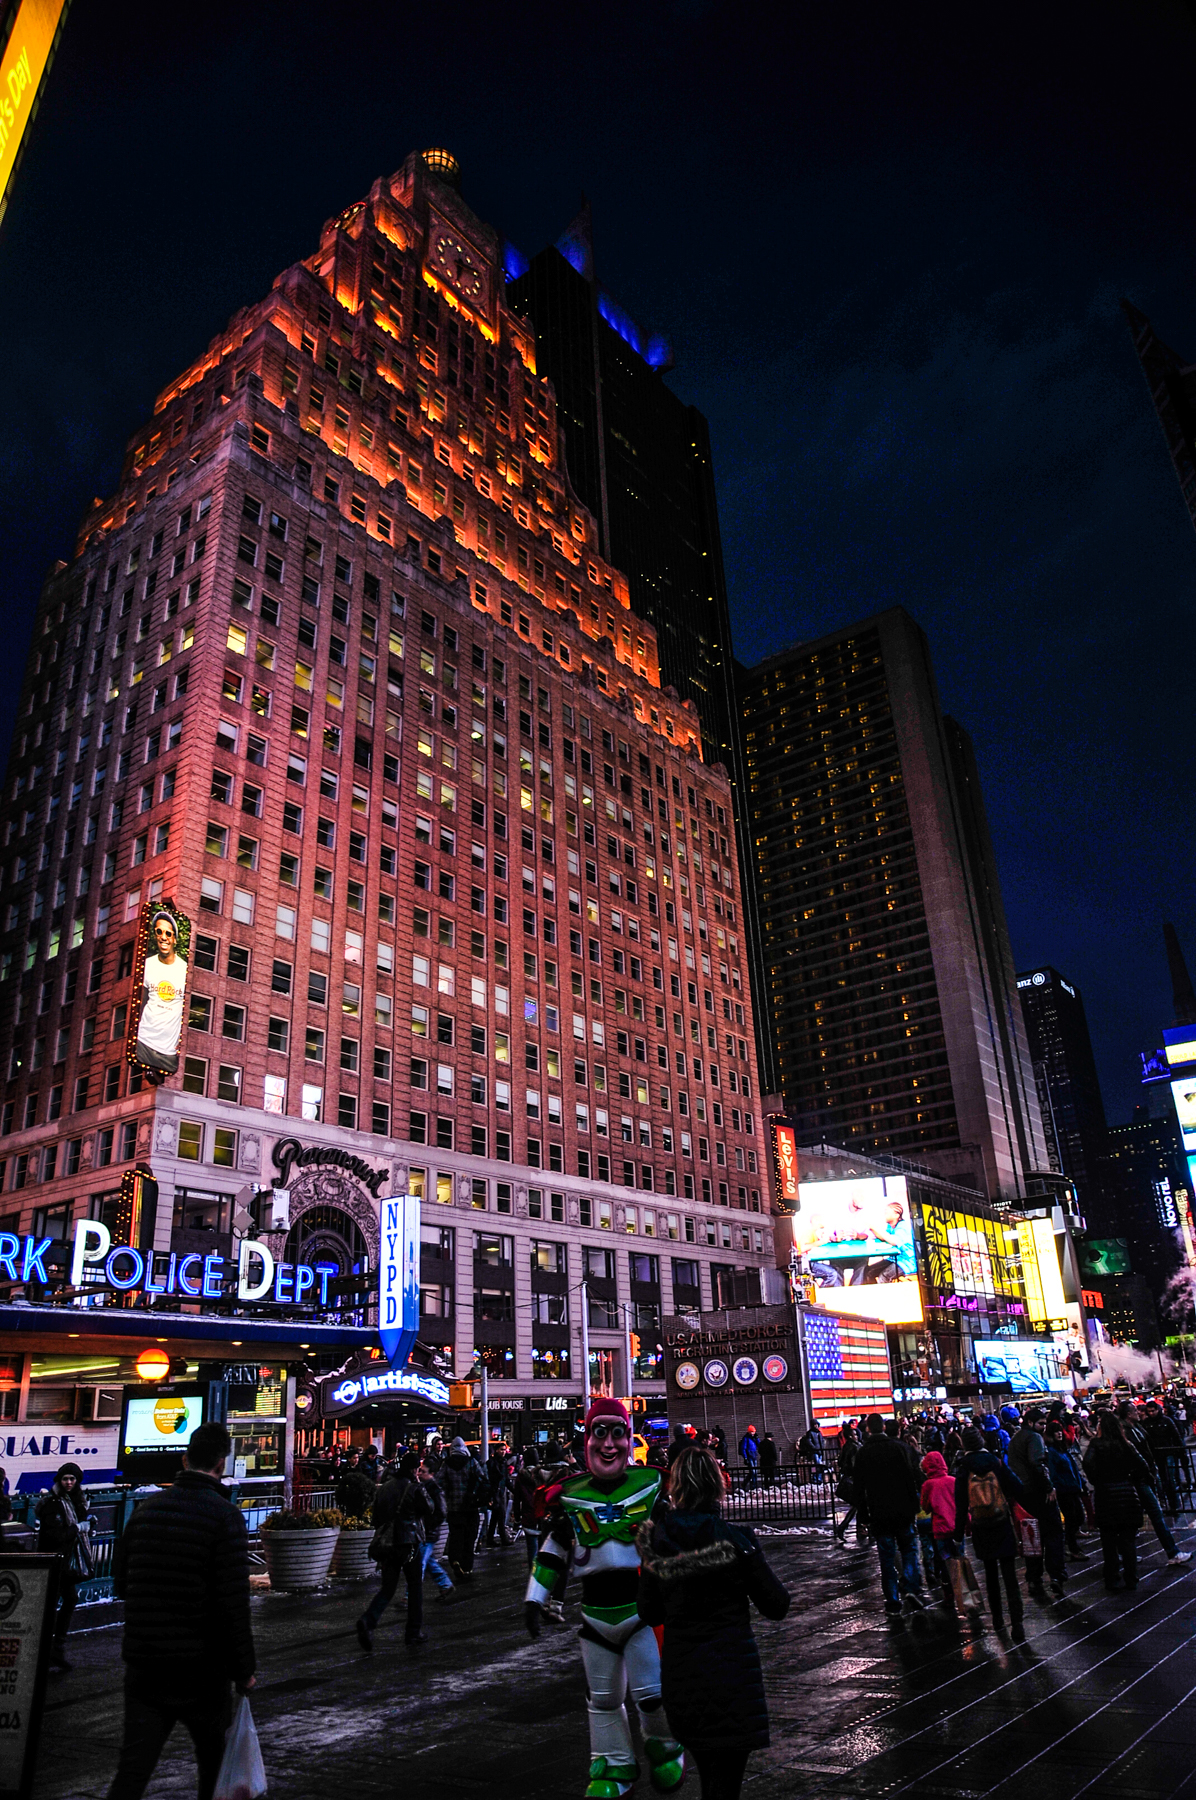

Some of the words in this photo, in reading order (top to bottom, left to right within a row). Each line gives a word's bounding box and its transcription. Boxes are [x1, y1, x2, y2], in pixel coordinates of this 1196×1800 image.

[7, 46, 32, 109] Day
[150, 983, 167, 993] Hard
[166, 985, 183, 997] Rock
[1033, 1078, 1053, 1136] TIMES
[271, 1137, 390, 1199] Paramount
[780, 1131, 797, 1195] Levi's
[1159, 1176, 1178, 1228] NOVOTEL
[71, 1219, 224, 1298] POLICE
[237, 1239, 335, 1306] DEPT
[386, 1202, 400, 1325] NYPD
[666, 1333, 688, 1347] U.S.
[690, 1328, 738, 1344] ARMED
[740, 1323, 793, 1340] FORCES
[673, 1343, 738, 1359] RECRUITING
[740, 1339, 788, 1353] STATION
[366, 1370, 418, 1394] artist
[545, 1396, 568, 1411] Lids
